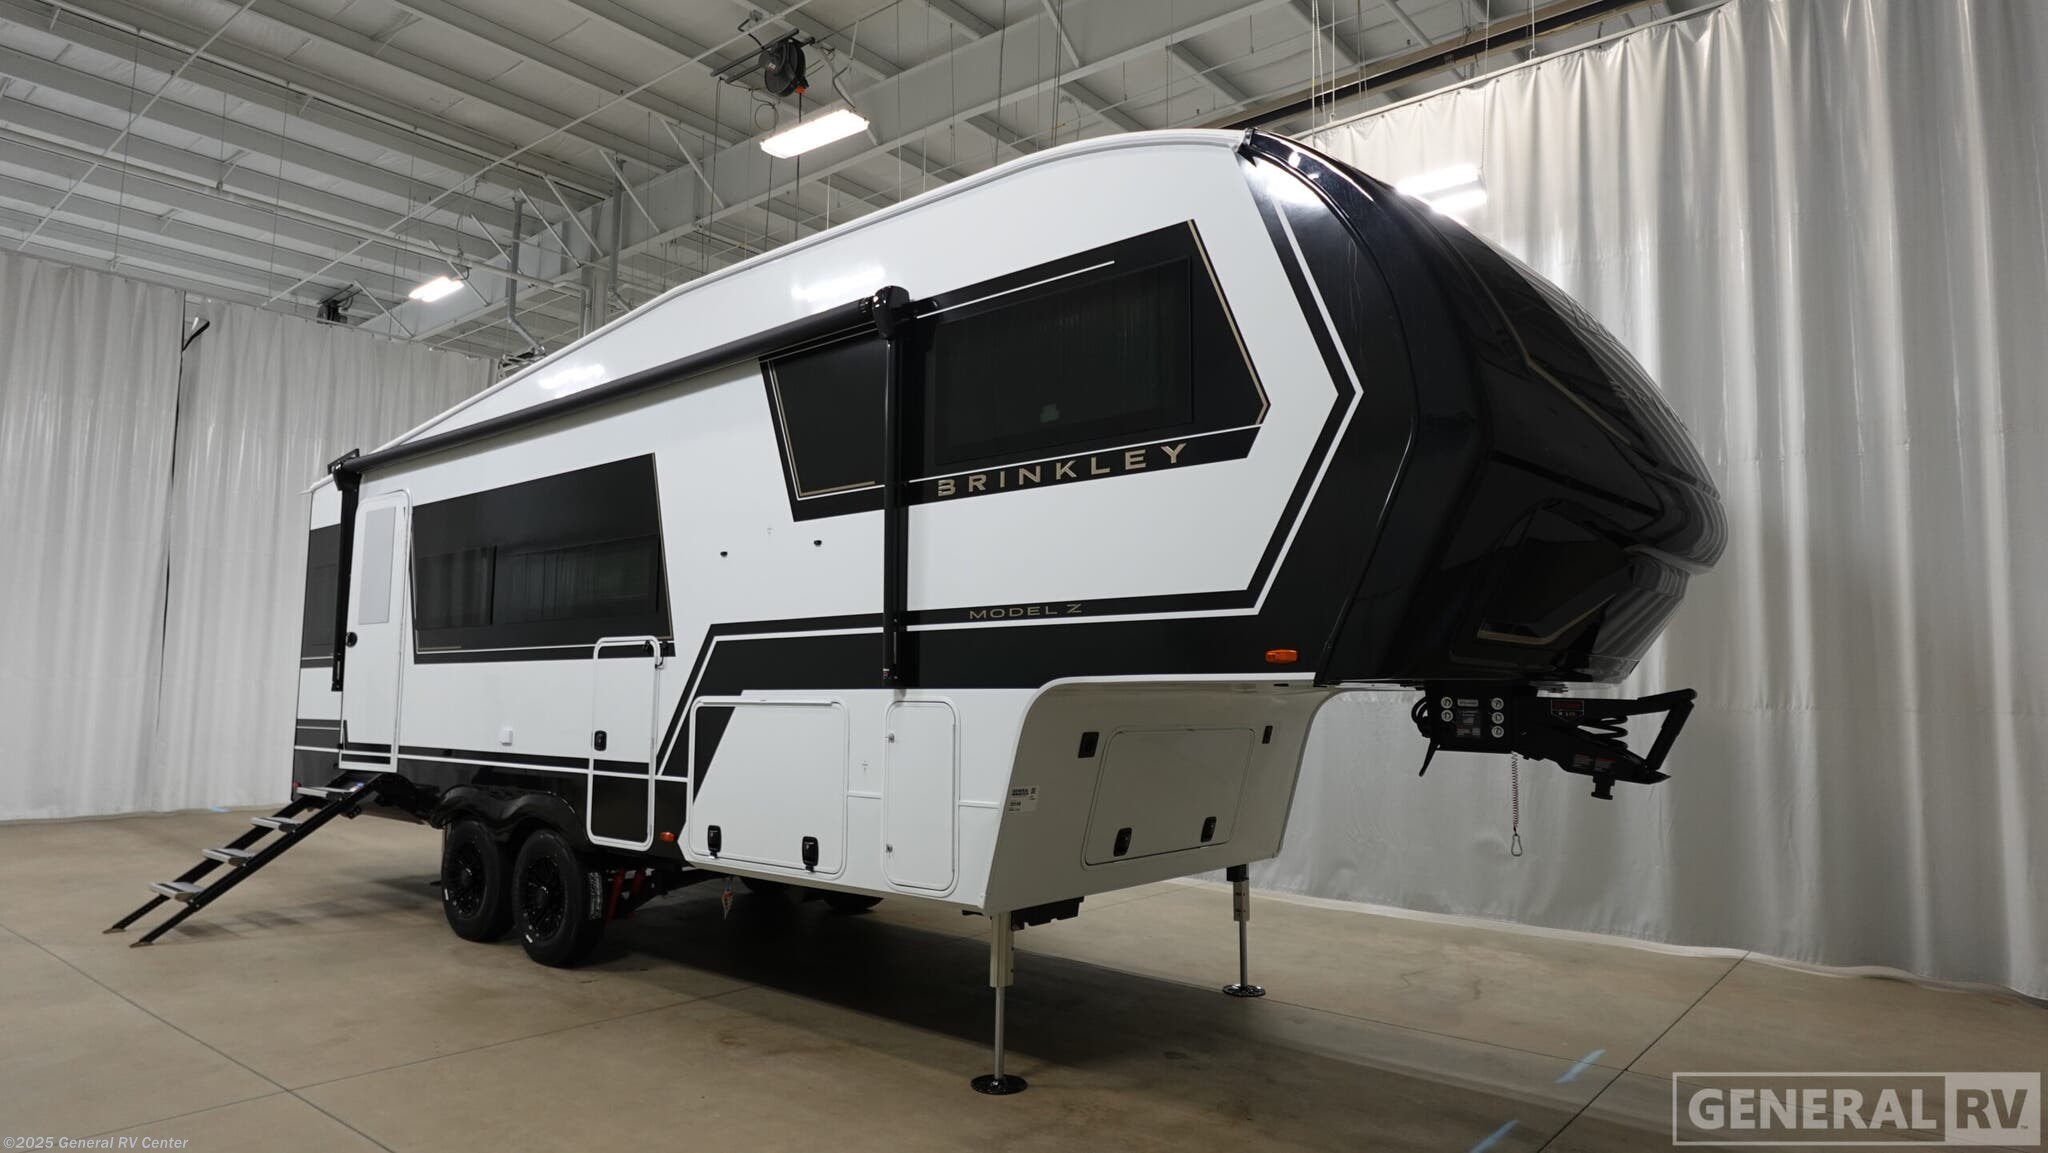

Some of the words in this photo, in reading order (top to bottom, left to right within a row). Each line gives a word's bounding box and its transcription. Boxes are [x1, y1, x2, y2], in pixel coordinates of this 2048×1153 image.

[938, 443, 1187, 497] BRINKLEY
[969, 605, 1058, 619] MODEL
[1066, 603, 1082, 614] Z
